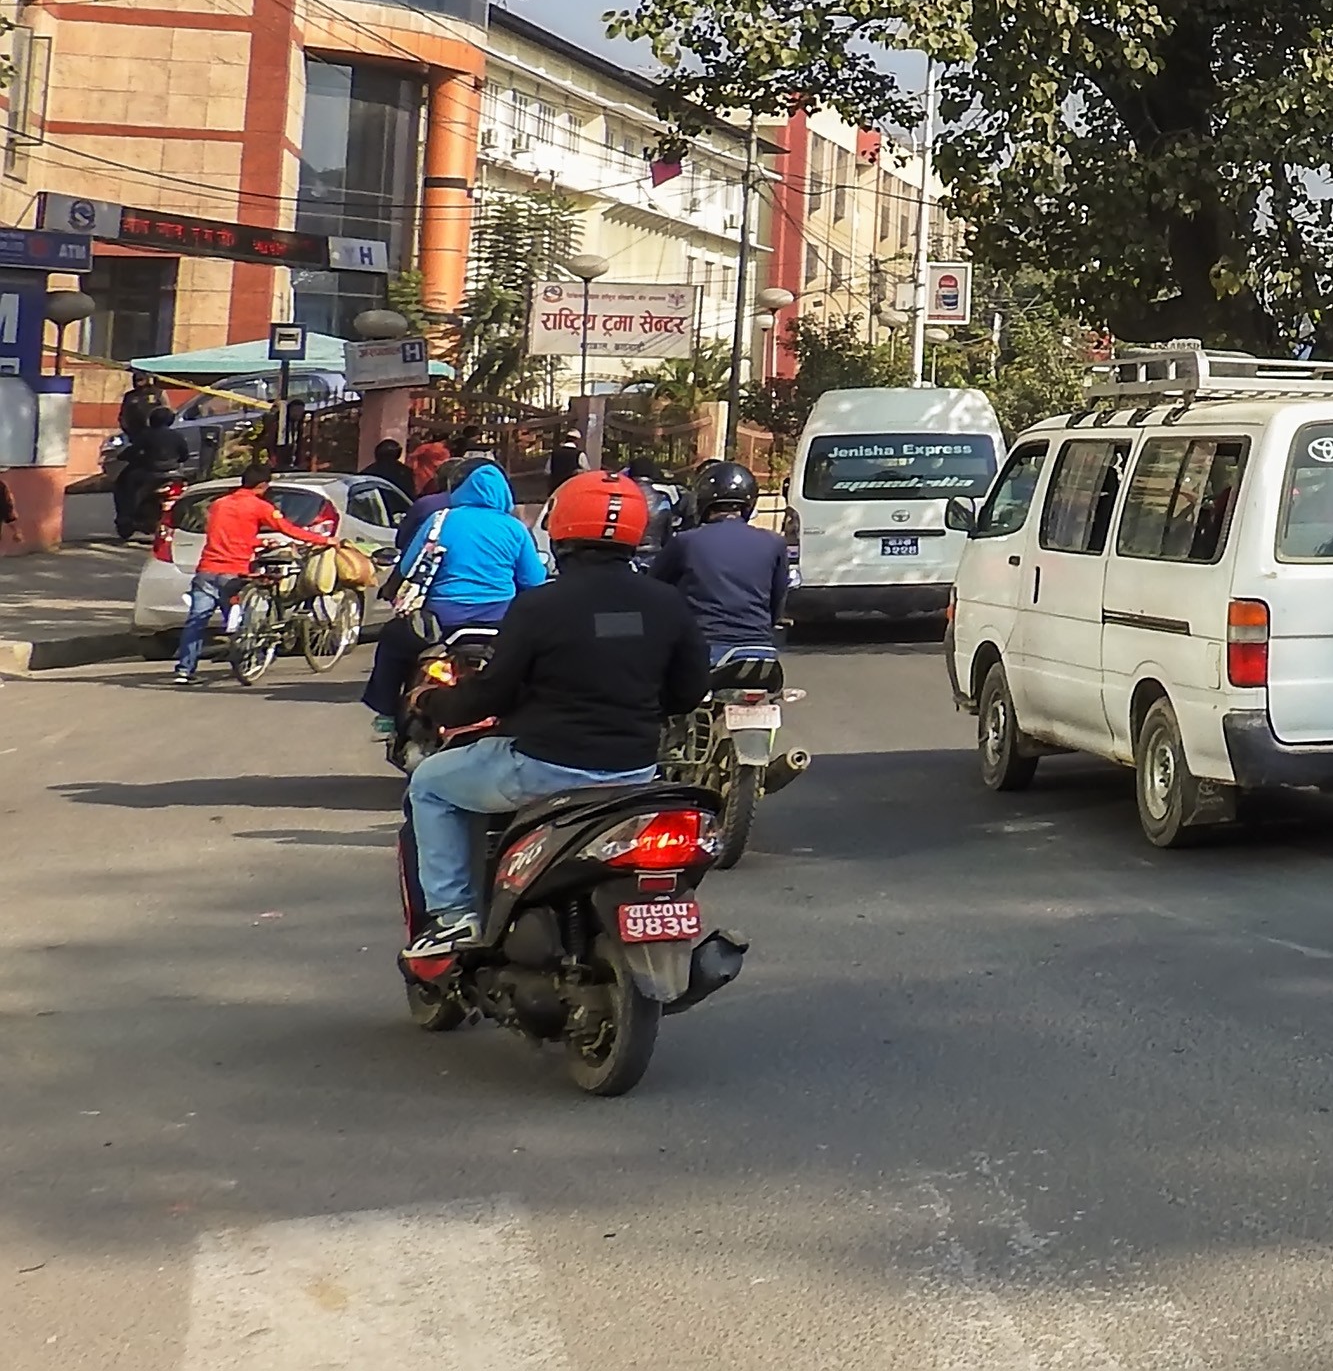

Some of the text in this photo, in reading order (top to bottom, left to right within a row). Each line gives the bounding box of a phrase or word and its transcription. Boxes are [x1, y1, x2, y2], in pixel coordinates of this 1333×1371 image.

[404, 343, 420, 361] H
[828, 443, 973, 459] Jenisha Express
